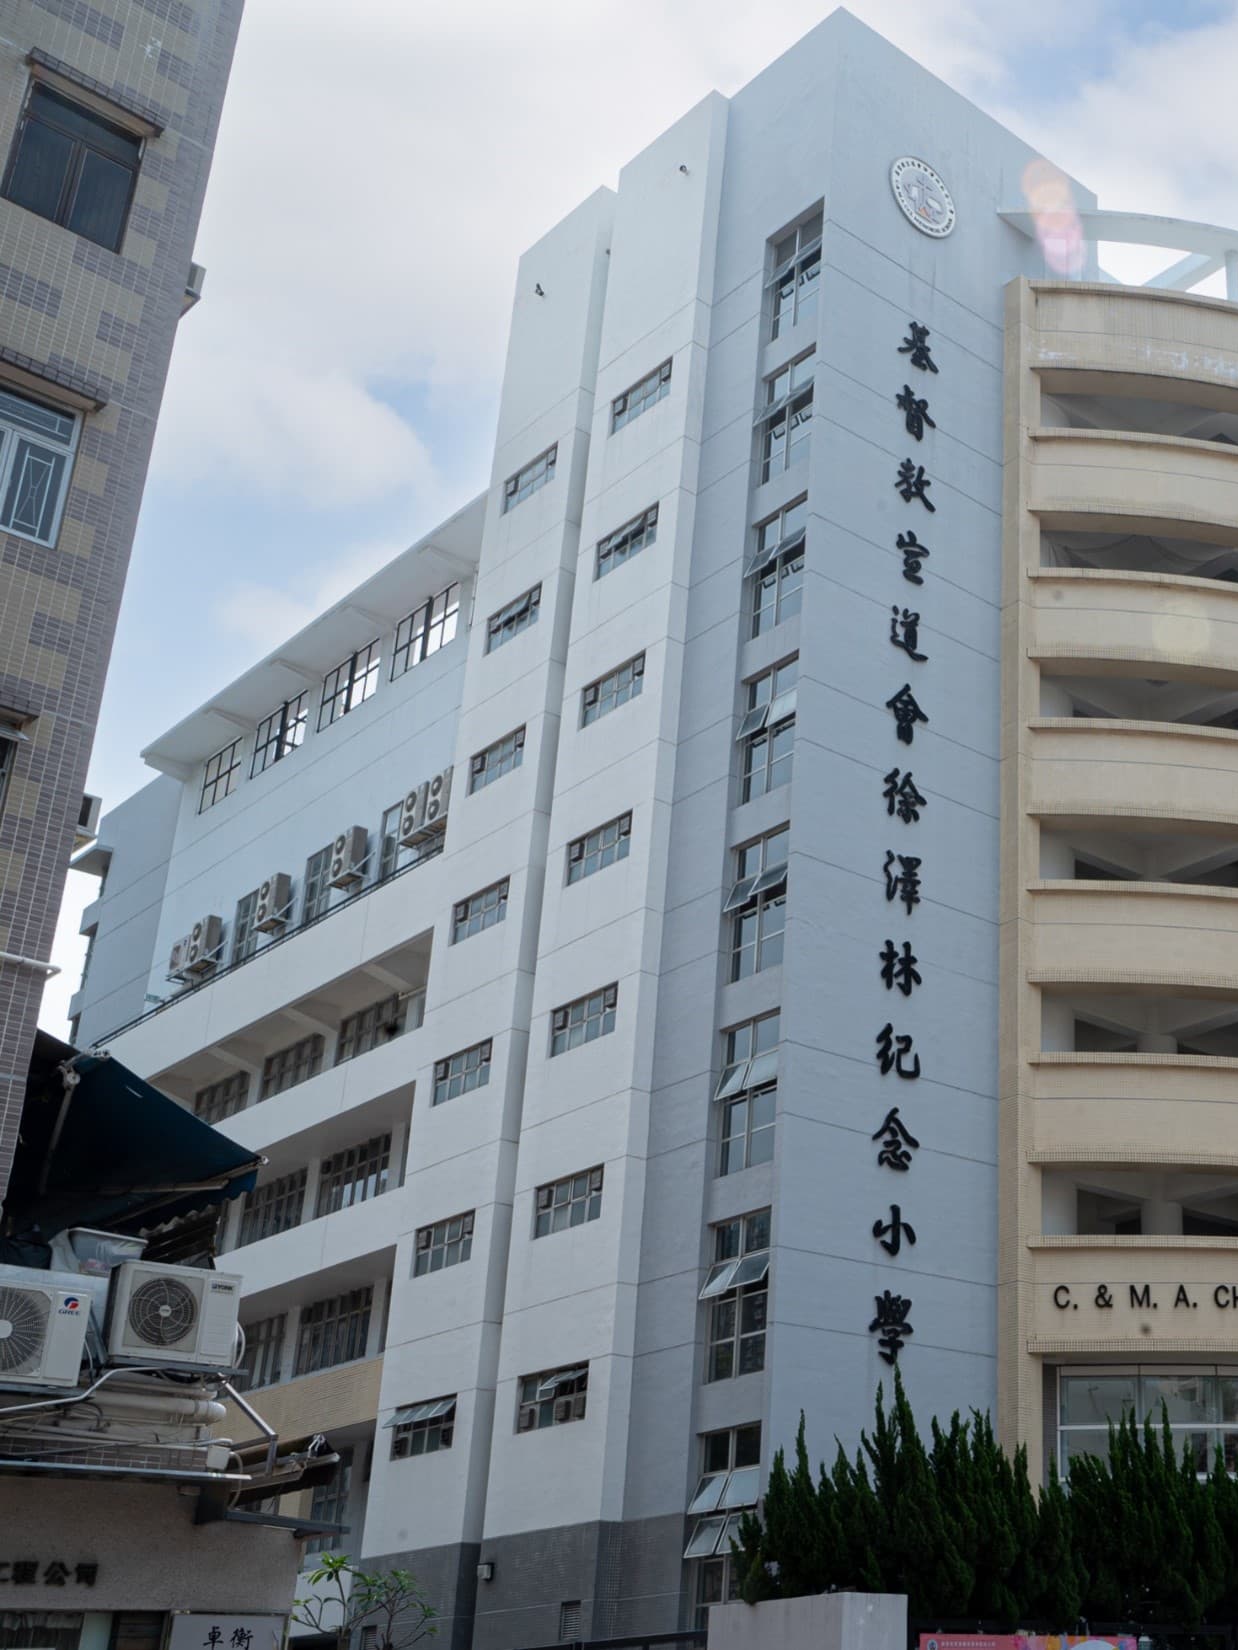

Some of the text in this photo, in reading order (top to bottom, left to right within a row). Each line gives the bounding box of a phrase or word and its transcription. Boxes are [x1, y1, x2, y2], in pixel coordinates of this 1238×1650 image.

[1053, 1285, 1079, 1310] C.
[1094, 1284, 1113, 1309] &
[1129, 1284, 1158, 1309] M.
[1174, 1284, 1198, 1308] A.
